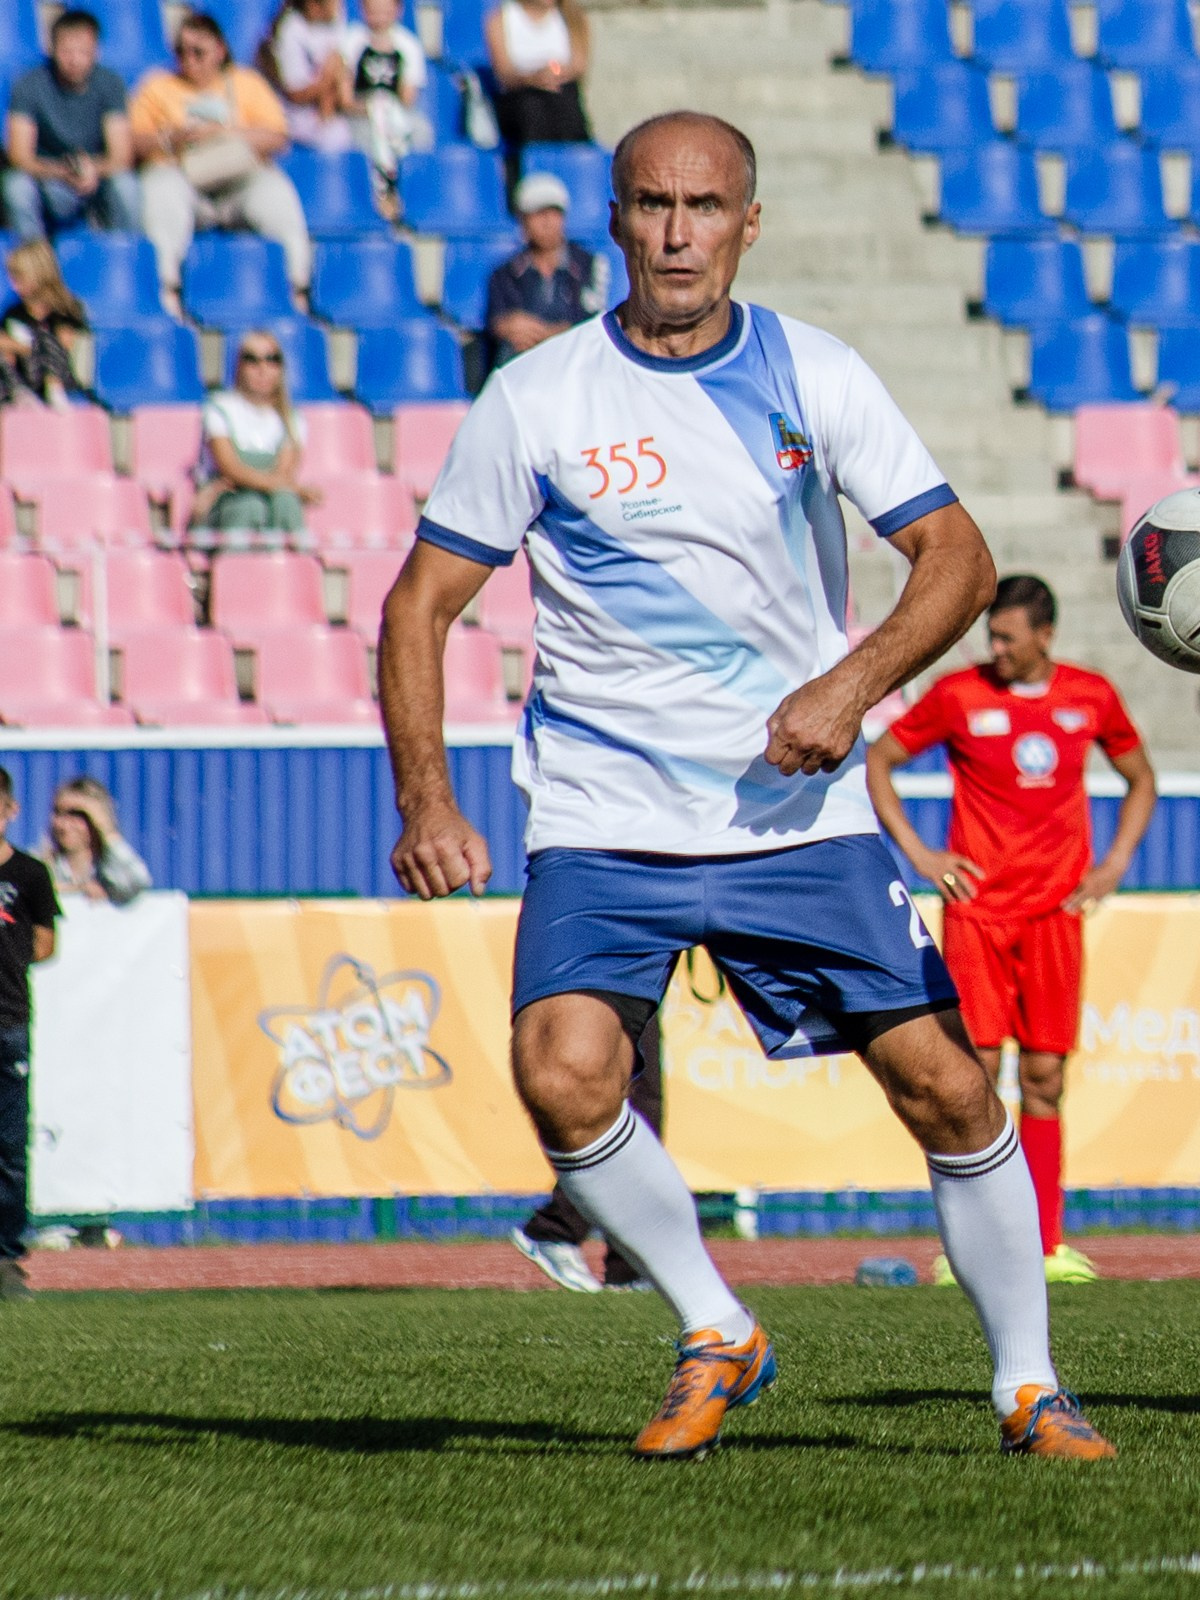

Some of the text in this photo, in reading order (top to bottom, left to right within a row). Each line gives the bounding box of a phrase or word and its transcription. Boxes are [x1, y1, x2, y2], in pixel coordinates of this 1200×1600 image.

[581, 436, 667, 499] 355
[622, 504, 682, 521] Сибирское
[888, 879, 935, 949] 2
[283, 988, 430, 1069] АТОМ
